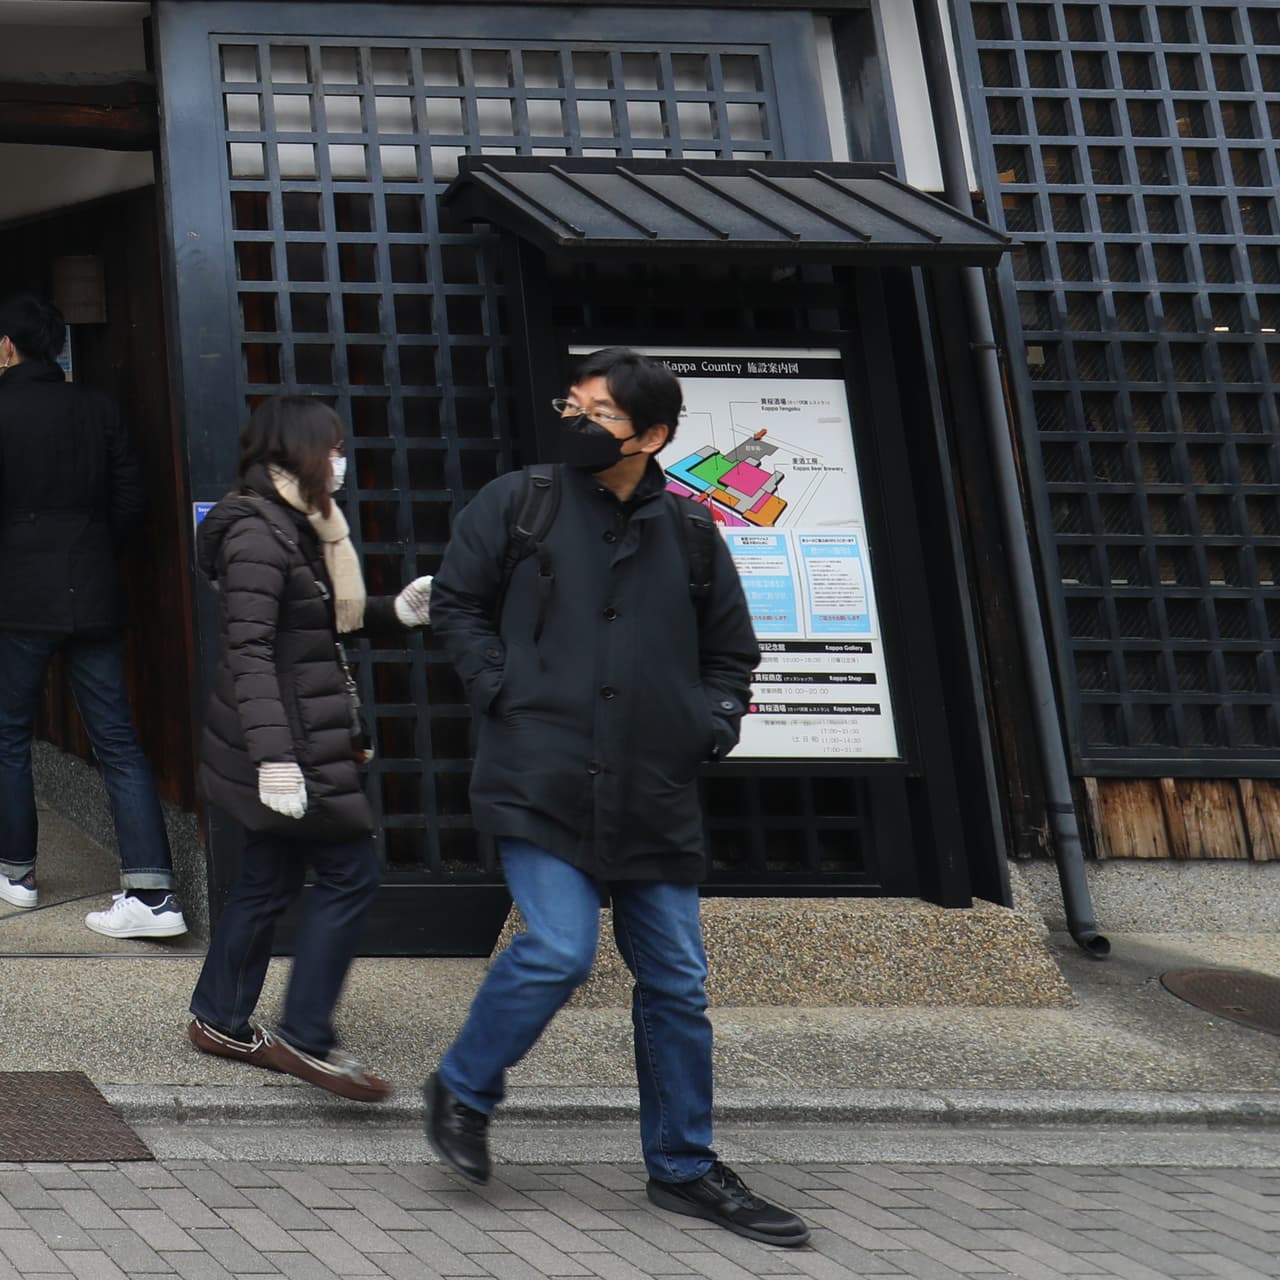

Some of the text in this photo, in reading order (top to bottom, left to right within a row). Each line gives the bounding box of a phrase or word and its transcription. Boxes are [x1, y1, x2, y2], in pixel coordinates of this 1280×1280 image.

[663, 361, 799, 374] Kappa Country 施設案内図
